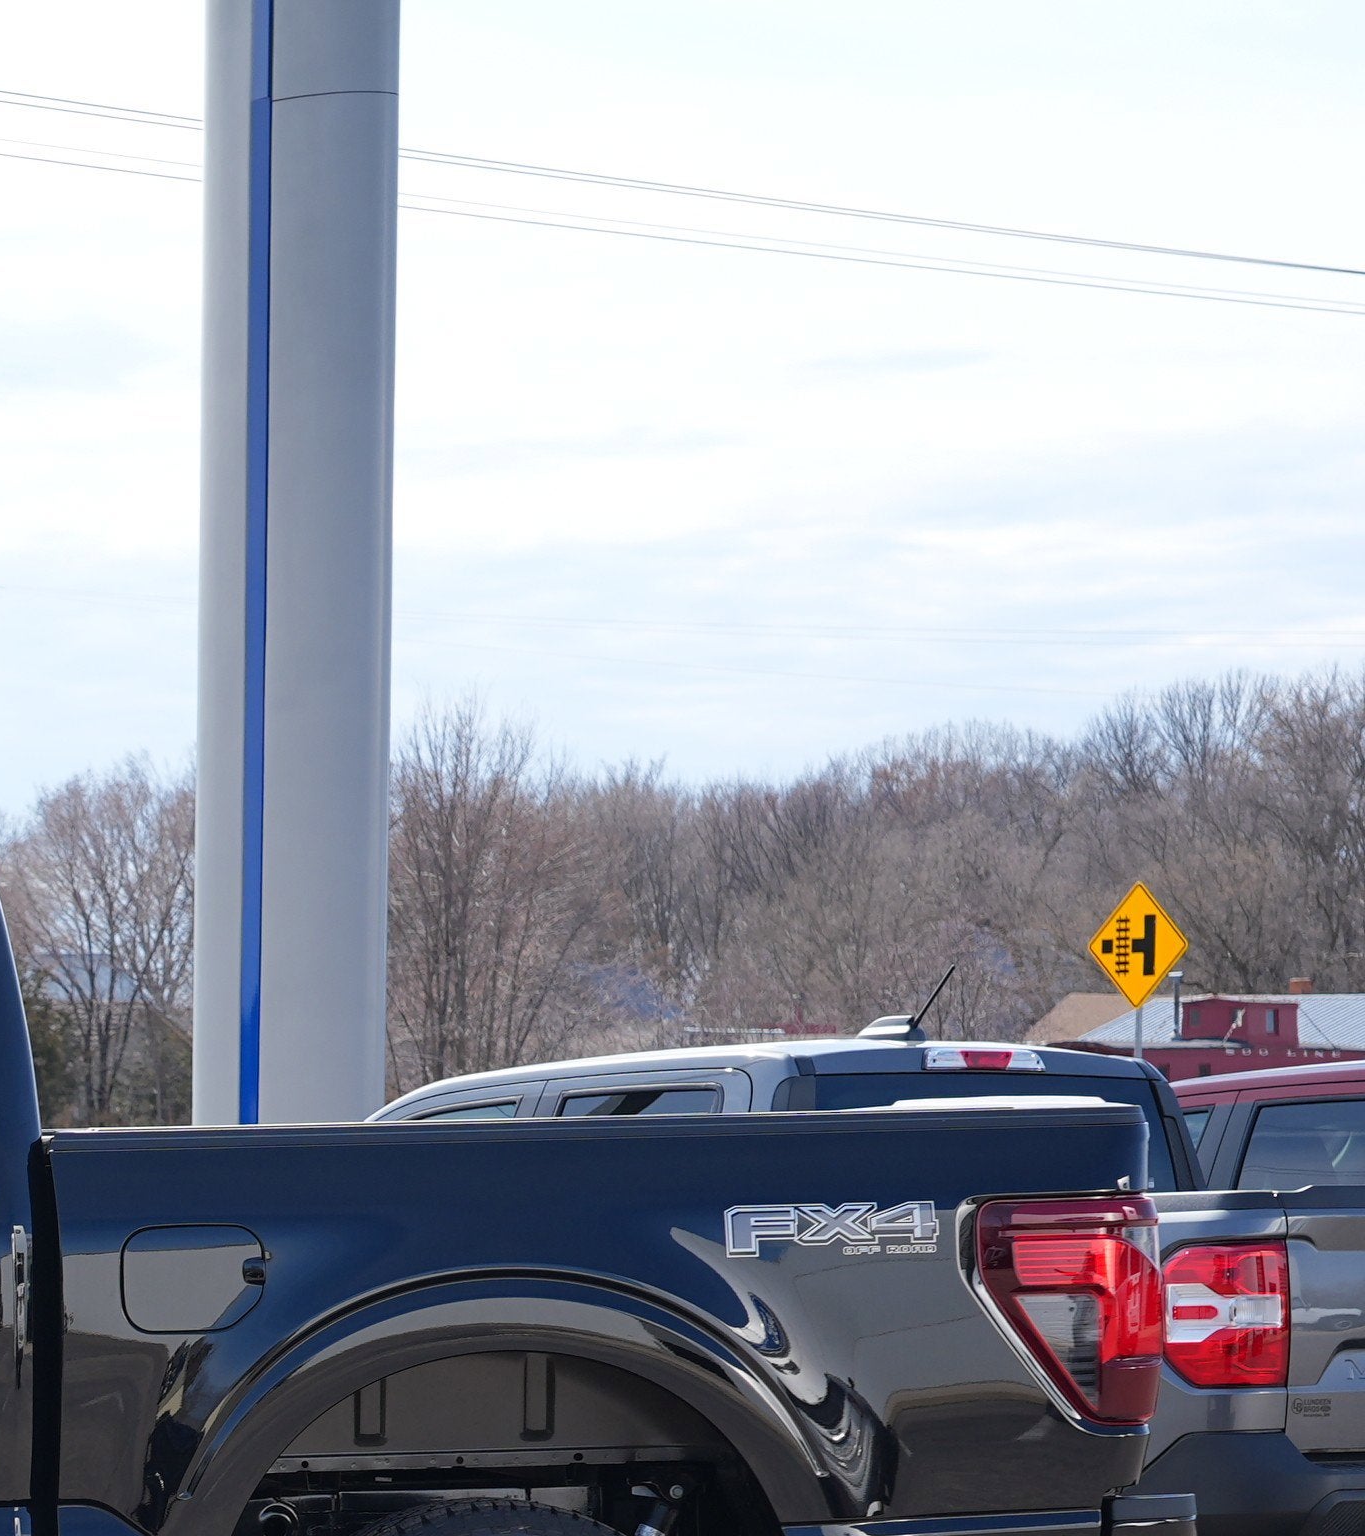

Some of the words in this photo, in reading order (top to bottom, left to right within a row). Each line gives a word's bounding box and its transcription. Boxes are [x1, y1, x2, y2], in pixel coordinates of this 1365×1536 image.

[724, 1200, 940, 1258] FX4
[842, 1245, 881, 1256] OFF
[886, 1244, 937, 1255] ROAD
